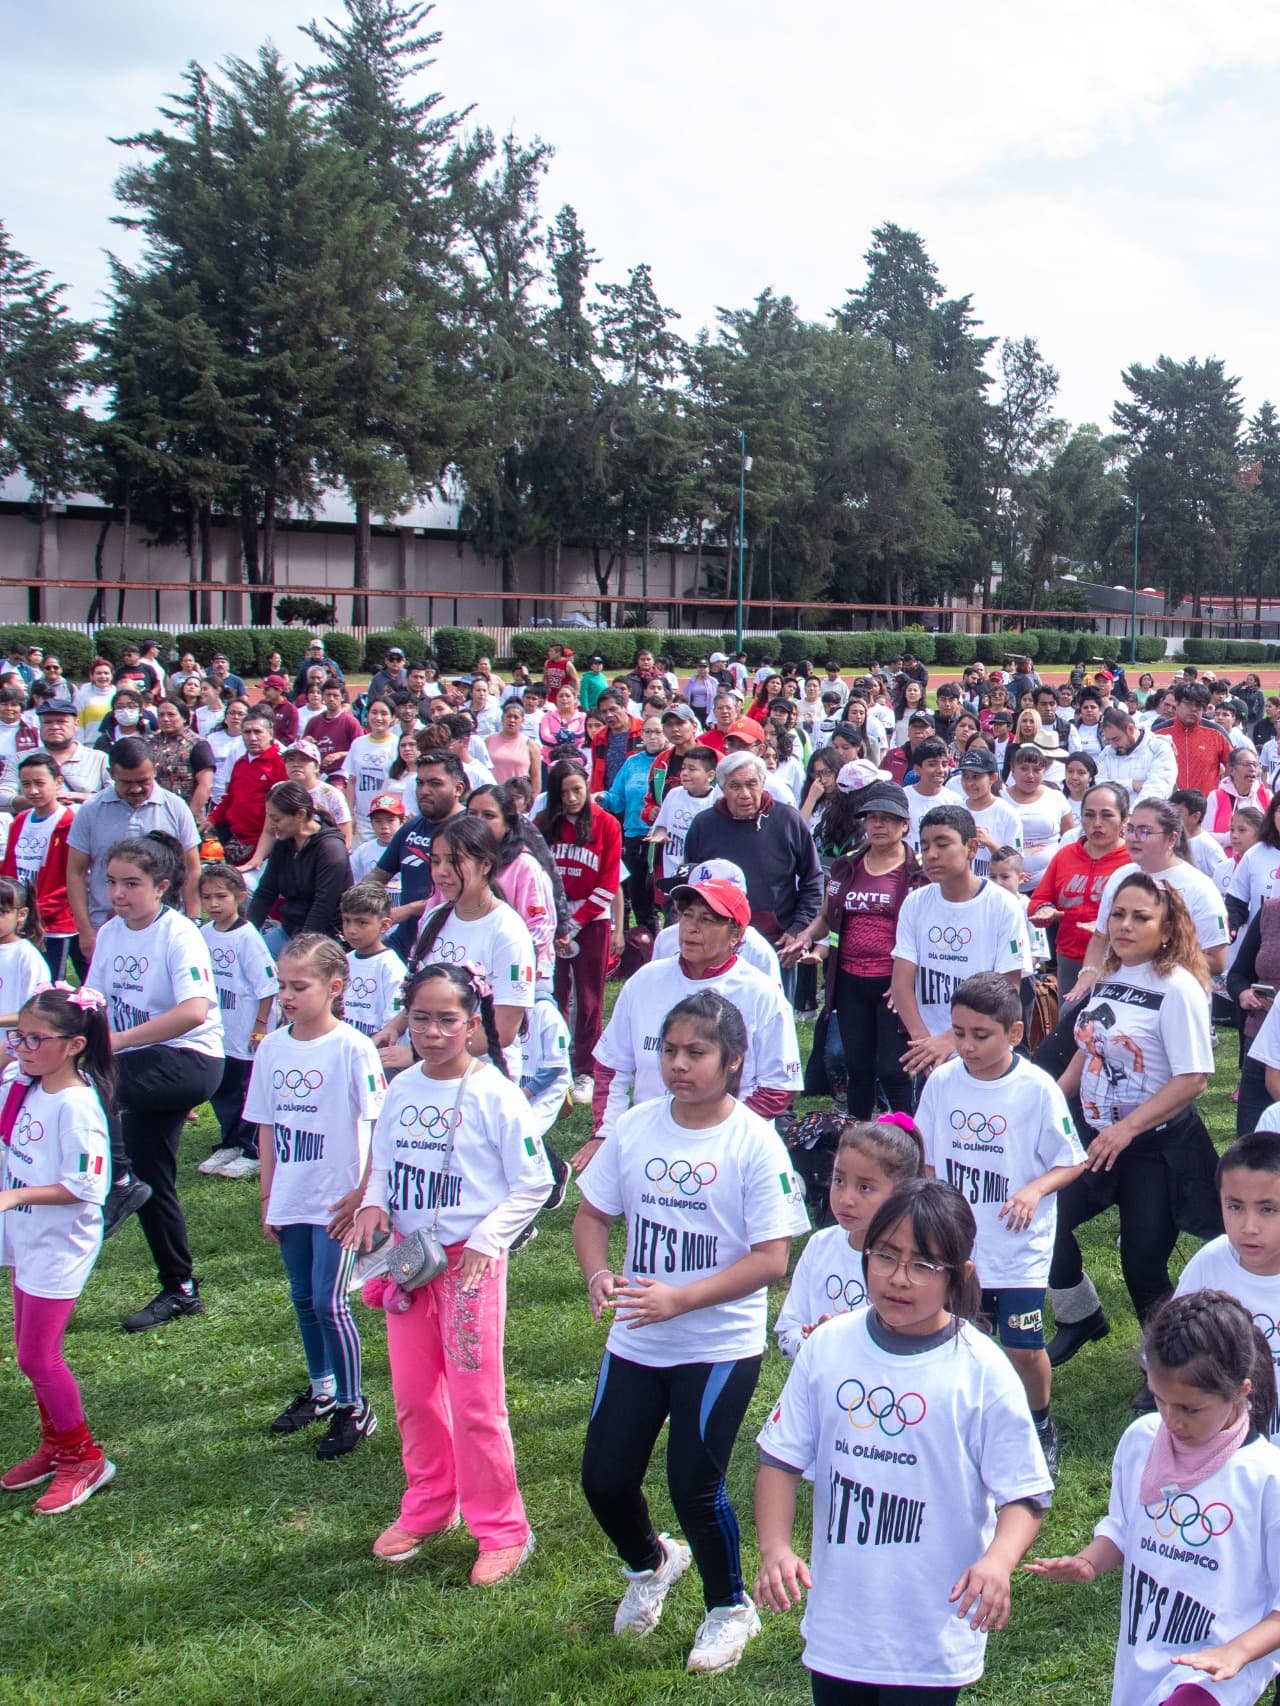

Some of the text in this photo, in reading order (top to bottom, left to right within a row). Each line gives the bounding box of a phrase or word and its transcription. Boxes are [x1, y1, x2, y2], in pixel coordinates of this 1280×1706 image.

[550, 677, 562, 689] 23
[405, 832, 431, 847] Ree
[846, 890, 891, 904] ONTE
[920, 966, 951, 1005] LET'S
[294, 1130, 325, 1162] MOVE
[951, 1139, 1005, 1155] DÍA OLÍMPICO
[426, 1171, 463, 1211] MOVE
[640, 1193, 708, 1211] DÍA OLÍMPICO
[631, 1213, 718, 1274] LET'S MOVE
[835, 1438, 918, 1467] DÍA OLÍMPICO
[874, 1490, 927, 1546] MOVE
[1140, 1536, 1220, 1572] DÍA OLÍMPICO
[1162, 1590, 1217, 1645] MOVE
